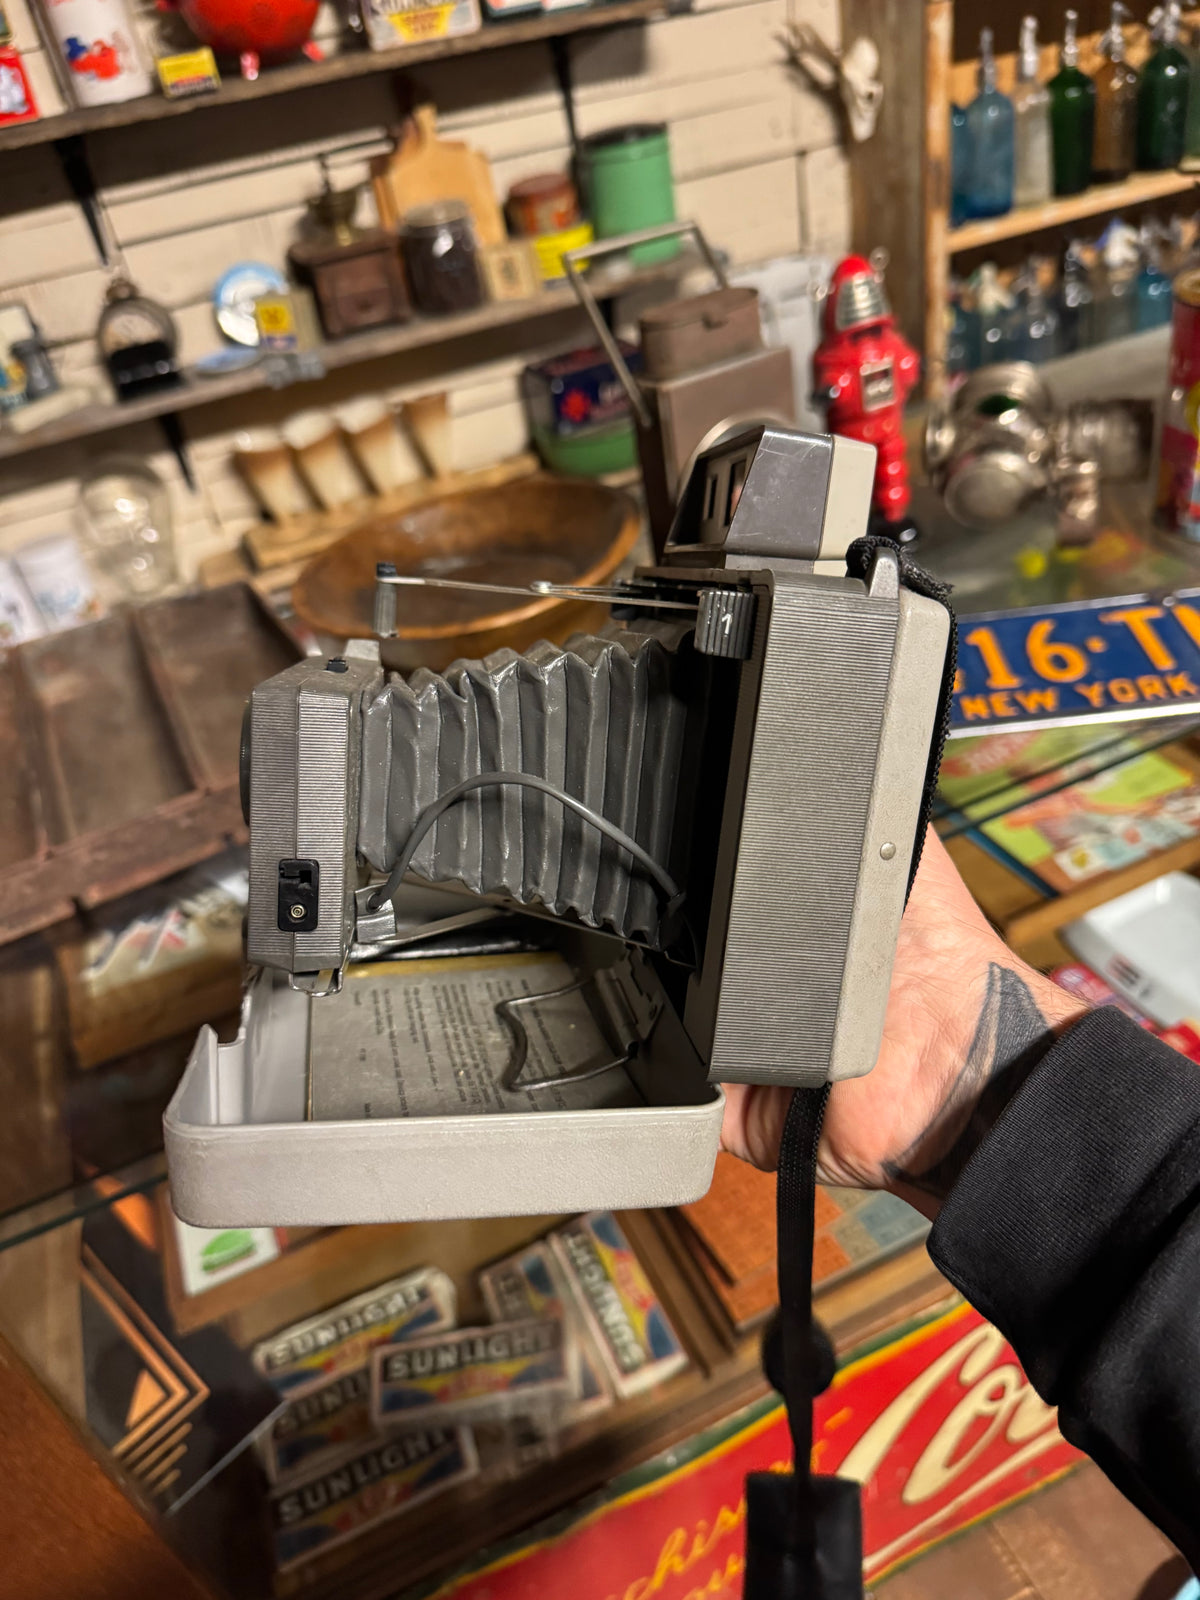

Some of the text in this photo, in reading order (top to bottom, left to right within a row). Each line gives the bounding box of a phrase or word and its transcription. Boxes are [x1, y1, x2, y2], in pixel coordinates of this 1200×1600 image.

[721, 612, 733, 635] 1
[960, 671, 1198, 721] NEW YORK
[270, 1284, 423, 1365] SUNLIGHT
[387, 1323, 555, 1381] SUNLIGHT
[279, 1424, 453, 1523] SUNLIGHT
